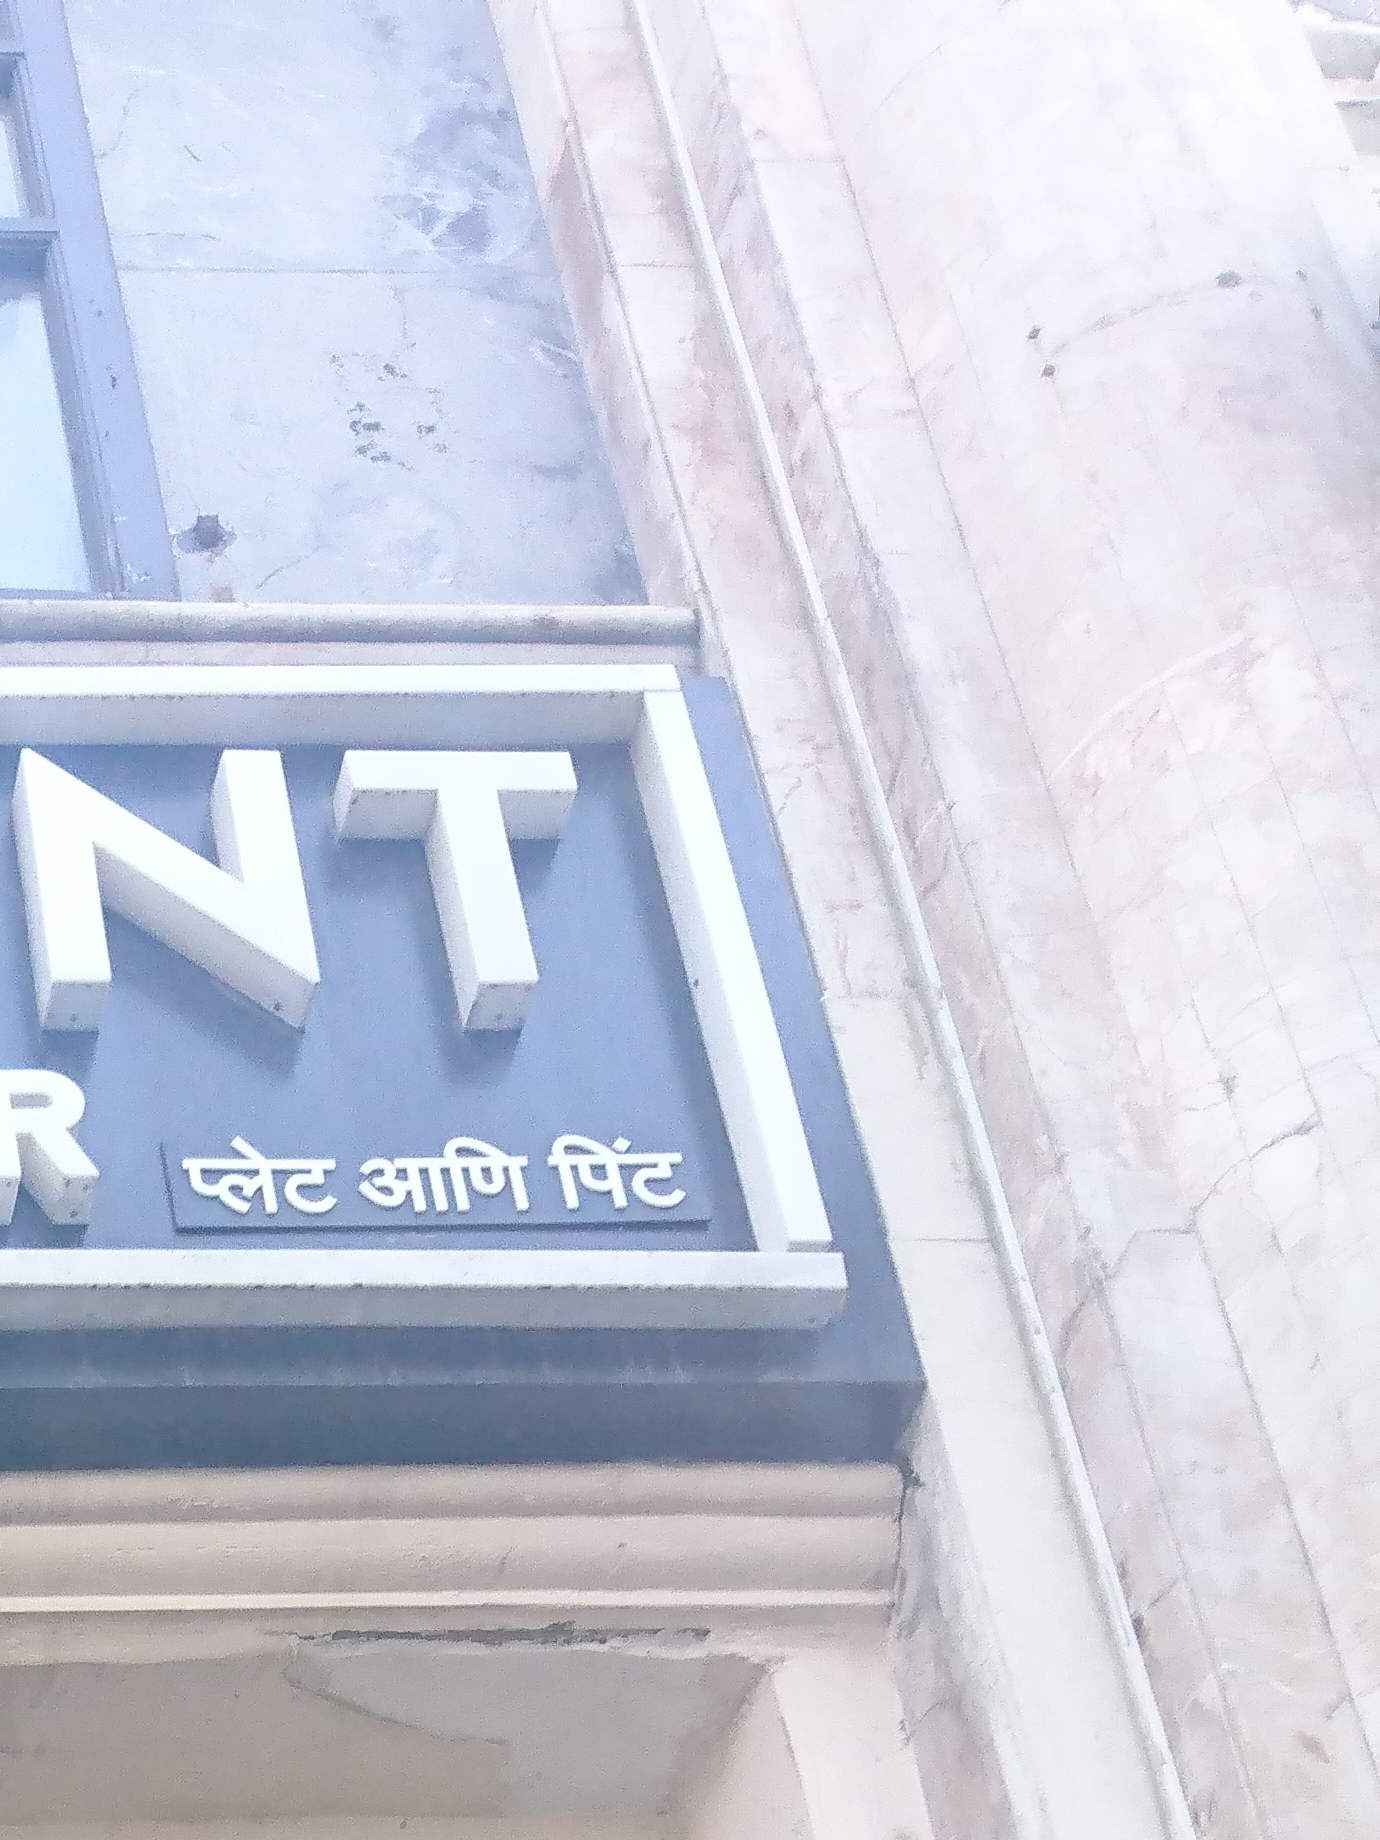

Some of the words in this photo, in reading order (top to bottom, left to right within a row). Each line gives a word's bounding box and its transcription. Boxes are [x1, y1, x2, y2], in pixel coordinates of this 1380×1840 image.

[182, 1135, 338, 1214] प्लेट
[357, 1136, 529, 1213] आणि
[547, 1133, 687, 1212] पिंट
